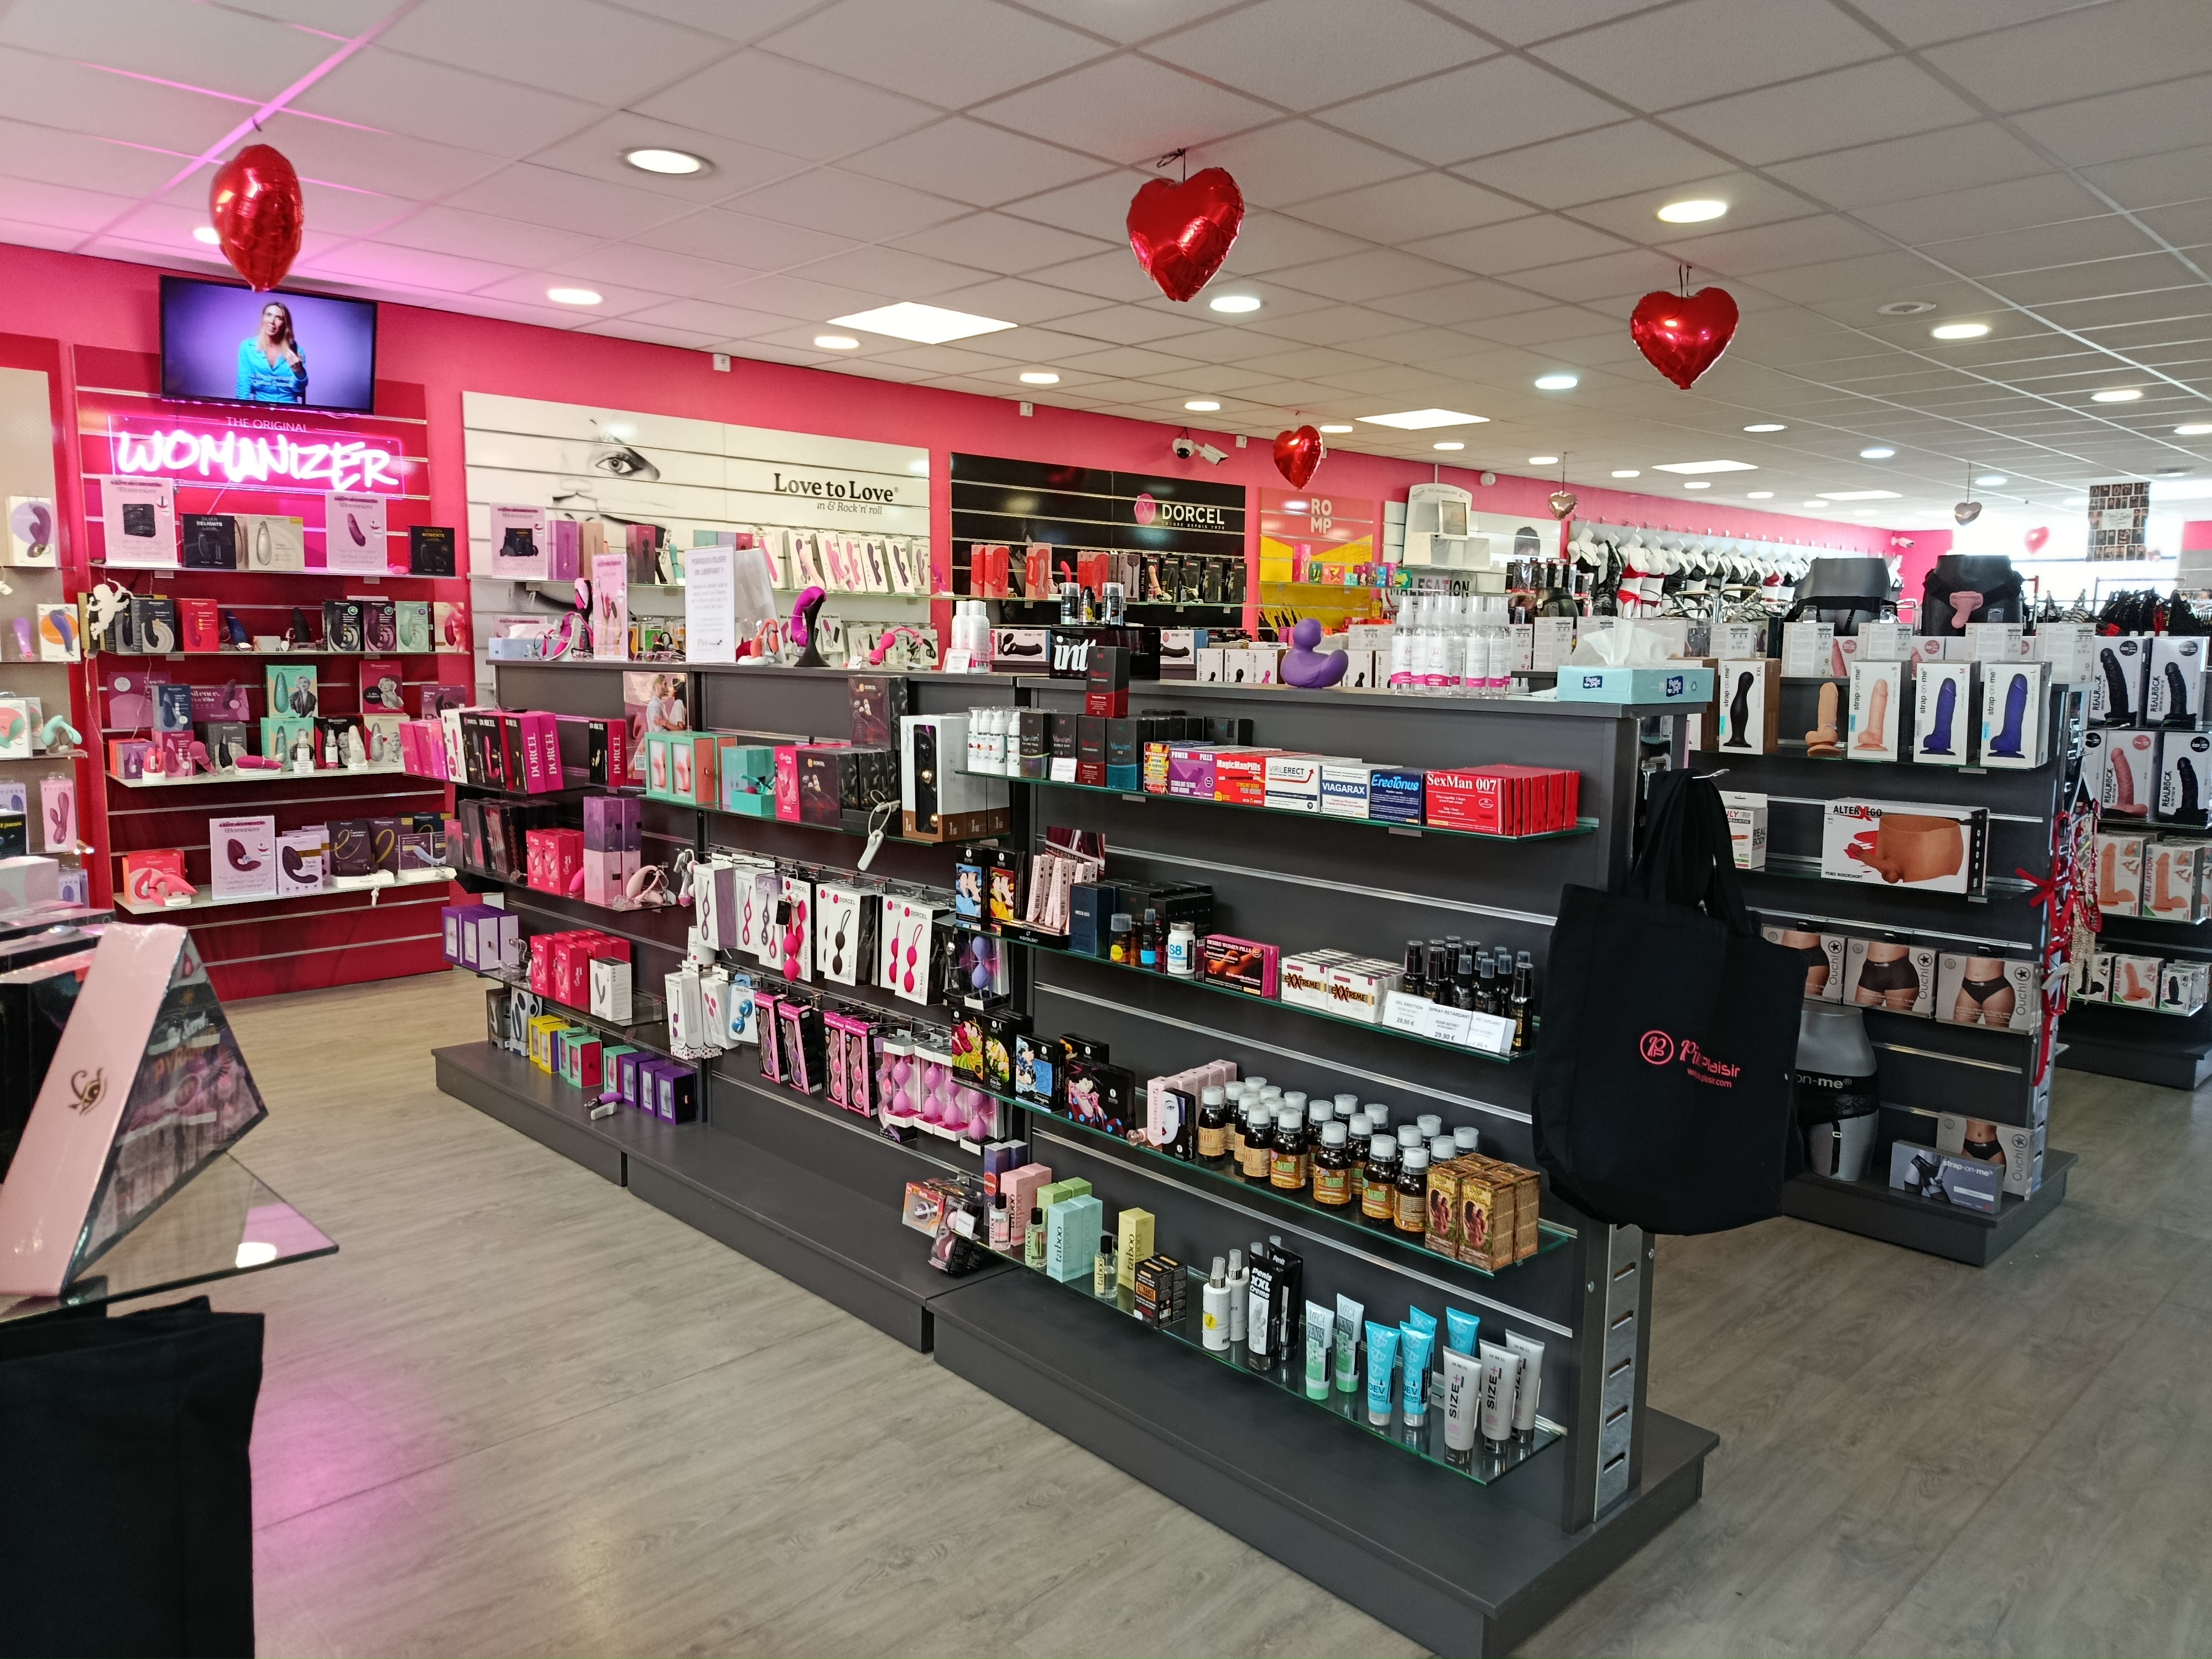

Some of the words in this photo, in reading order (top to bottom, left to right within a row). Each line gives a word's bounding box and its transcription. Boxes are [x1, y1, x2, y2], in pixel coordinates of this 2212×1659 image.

[226, 416, 249, 427] THE
[253, 419, 309, 433] ORIGINAL
[117, 429, 399, 491] WOMANIZER
[774, 473, 822, 495] Love
[826, 481, 845, 497] to
[828, 501, 835, 510] &
[837, 502, 857, 512] Rock
[869, 506, 883, 514] roll
[1162, 504, 1224, 524] DORCEL
[1311, 498, 1332, 515] RO
[1311, 517, 1332, 534] MP
[1054, 635, 1096, 671] int
[528, 733, 540, 778] DORCEL
[545, 731, 557, 775] DORCEL
[613, 734, 621, 774] DORCEL
[1171, 751, 1188, 759] POWER
[1269, 766, 1305, 775] VIRILERECT
[1322, 782, 1365, 795] VIAGARAX
[1427, 774, 1473, 789] SexMan
[1476, 778, 1497, 791] 007
[1754, 827, 1766, 838] REAL
[1752, 837, 1766, 846] BODY
[910, 911, 927, 920] DORCEL
[1169, 945, 1182, 956] S8
[1222, 942, 1238, 951] WOMEN
[1829, 954, 1839, 985] Ouch!
[1918, 967, 1929, 1000] Ouch!
[2016, 983, 2026, 1015] Ouch!
[1430, 1006, 1443, 1015] SPRAY
[1444, 1010, 1470, 1019] RETARDANT
[2012, 1150, 2023, 1181] Ouch!
[1127, 1234, 1135, 1271] taboo
[1272, 1255, 1286, 1266] Penis
[1251, 1267, 1272, 1282] Penis
[1249, 1285, 1270, 1299] Creme
[1250, 1276, 1271, 1292] XXL
[1308, 1311, 1326, 1327] MEGA
[1339, 1302, 1355, 1321] MEGA
[1307, 1323, 1324, 1341] PENIS
[1337, 1317, 1354, 1334] PENIS
[1486, 1365, 1499, 1410] SIZE+
[1449, 1374, 1460, 1419] SIZE+
